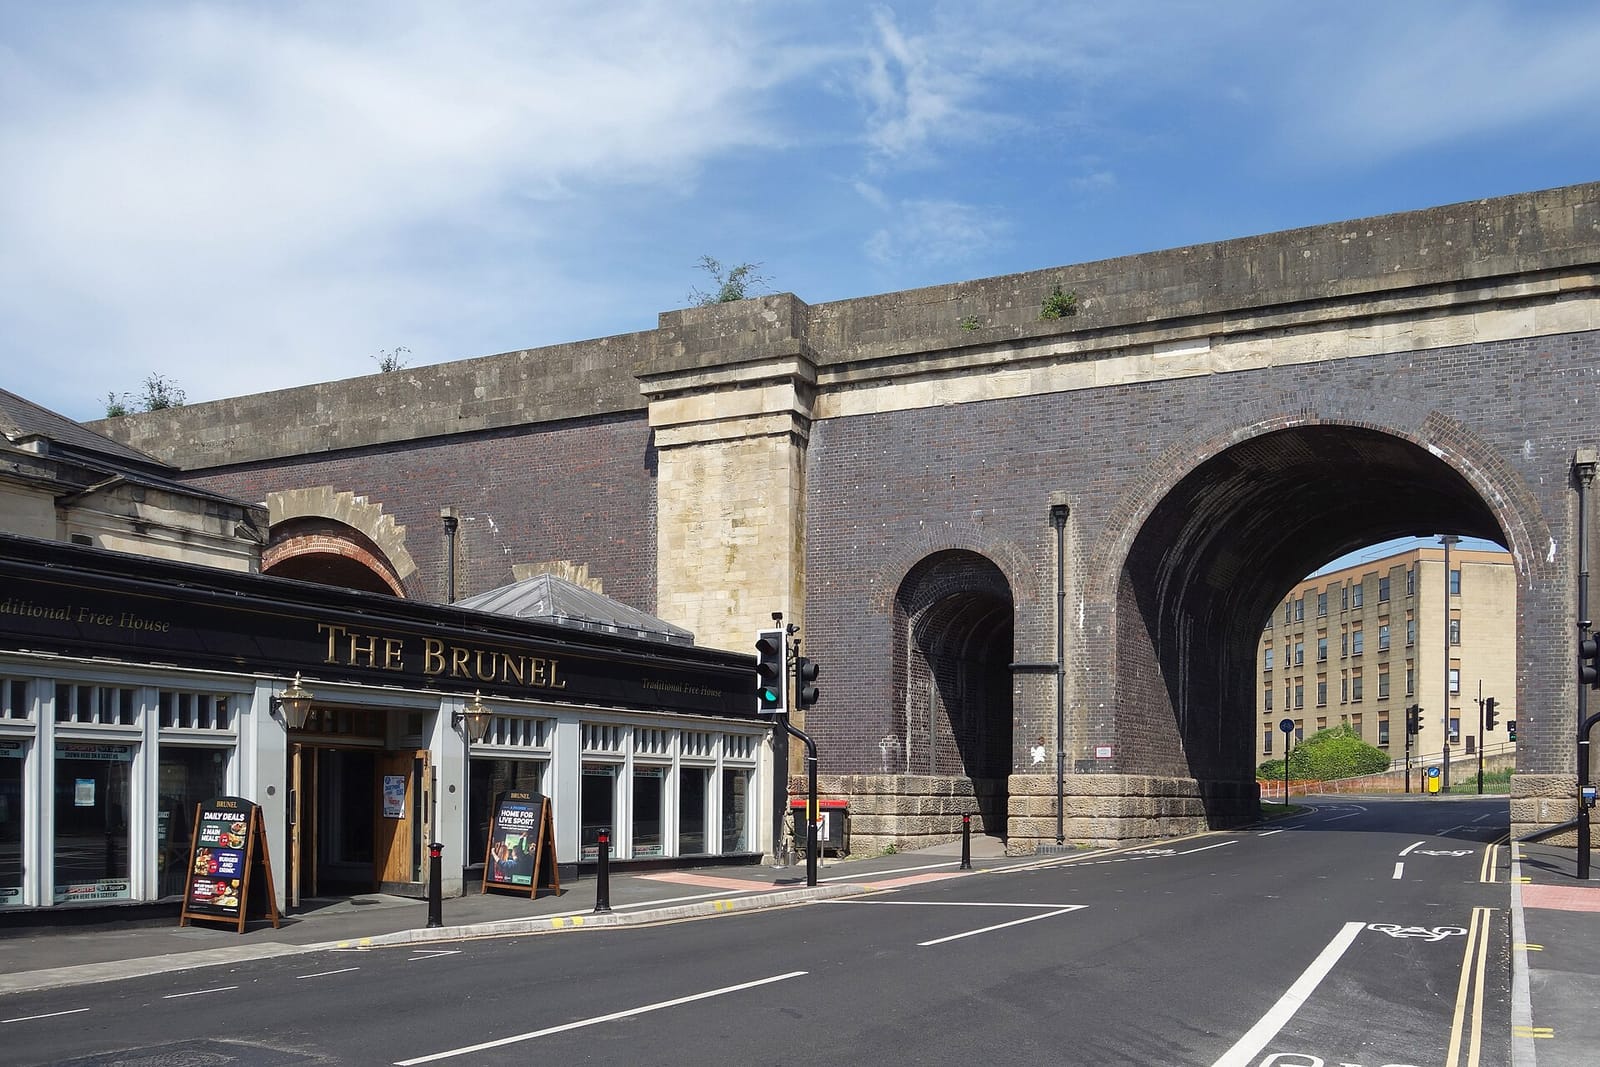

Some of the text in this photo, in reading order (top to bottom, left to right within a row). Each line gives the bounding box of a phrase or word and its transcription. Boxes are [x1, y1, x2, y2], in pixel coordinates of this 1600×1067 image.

[77, 607, 113, 626] Free
[119, 612, 170, 633] House
[642, 678, 721, 697] Traditional Free House
[216, 800, 237, 808] BRUNEL
[203, 812, 245, 821] DAILY DEALS
[501, 810, 519, 818] HOME
[513, 818, 534, 826] SPORT
